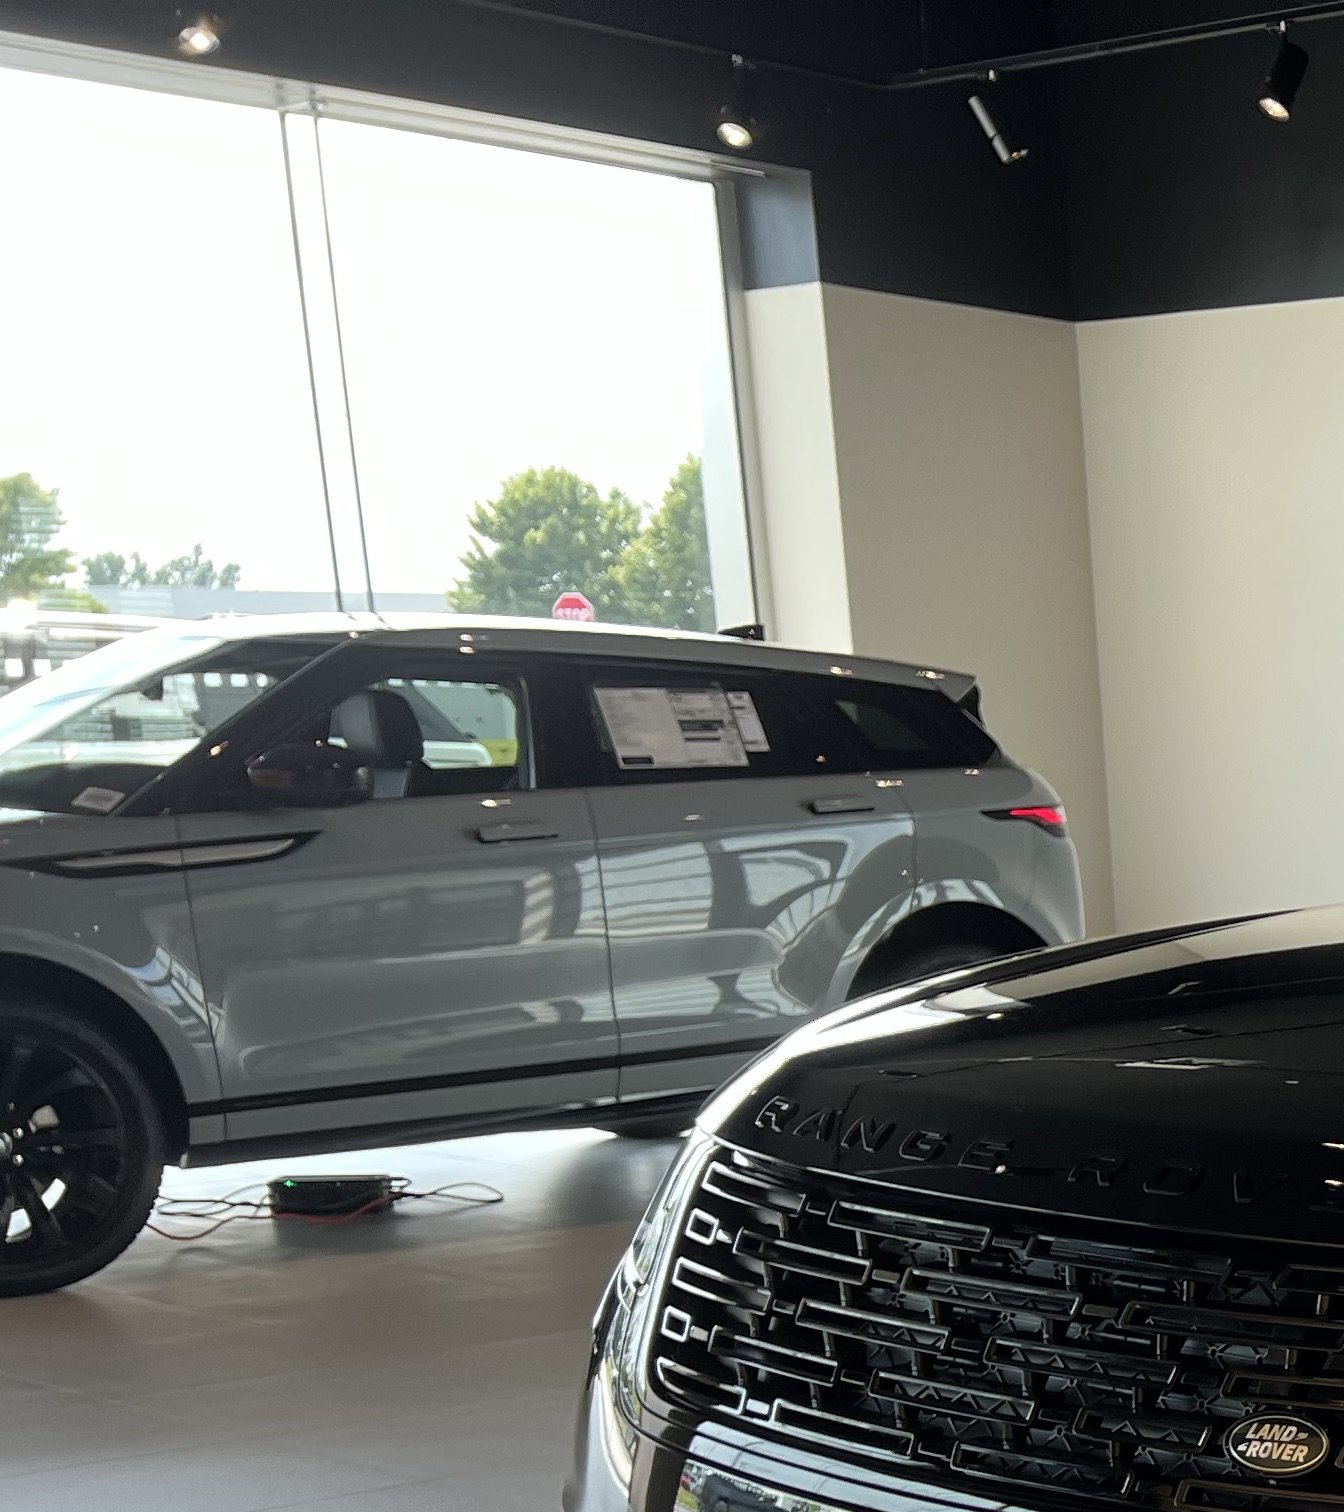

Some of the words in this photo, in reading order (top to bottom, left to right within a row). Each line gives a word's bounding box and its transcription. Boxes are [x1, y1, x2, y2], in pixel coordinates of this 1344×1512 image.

[754, 1094, 1017, 1176] RANGE
[1245, 1422, 1298, 1442] LAND
[1245, 1441, 1309, 1463] ROVER
